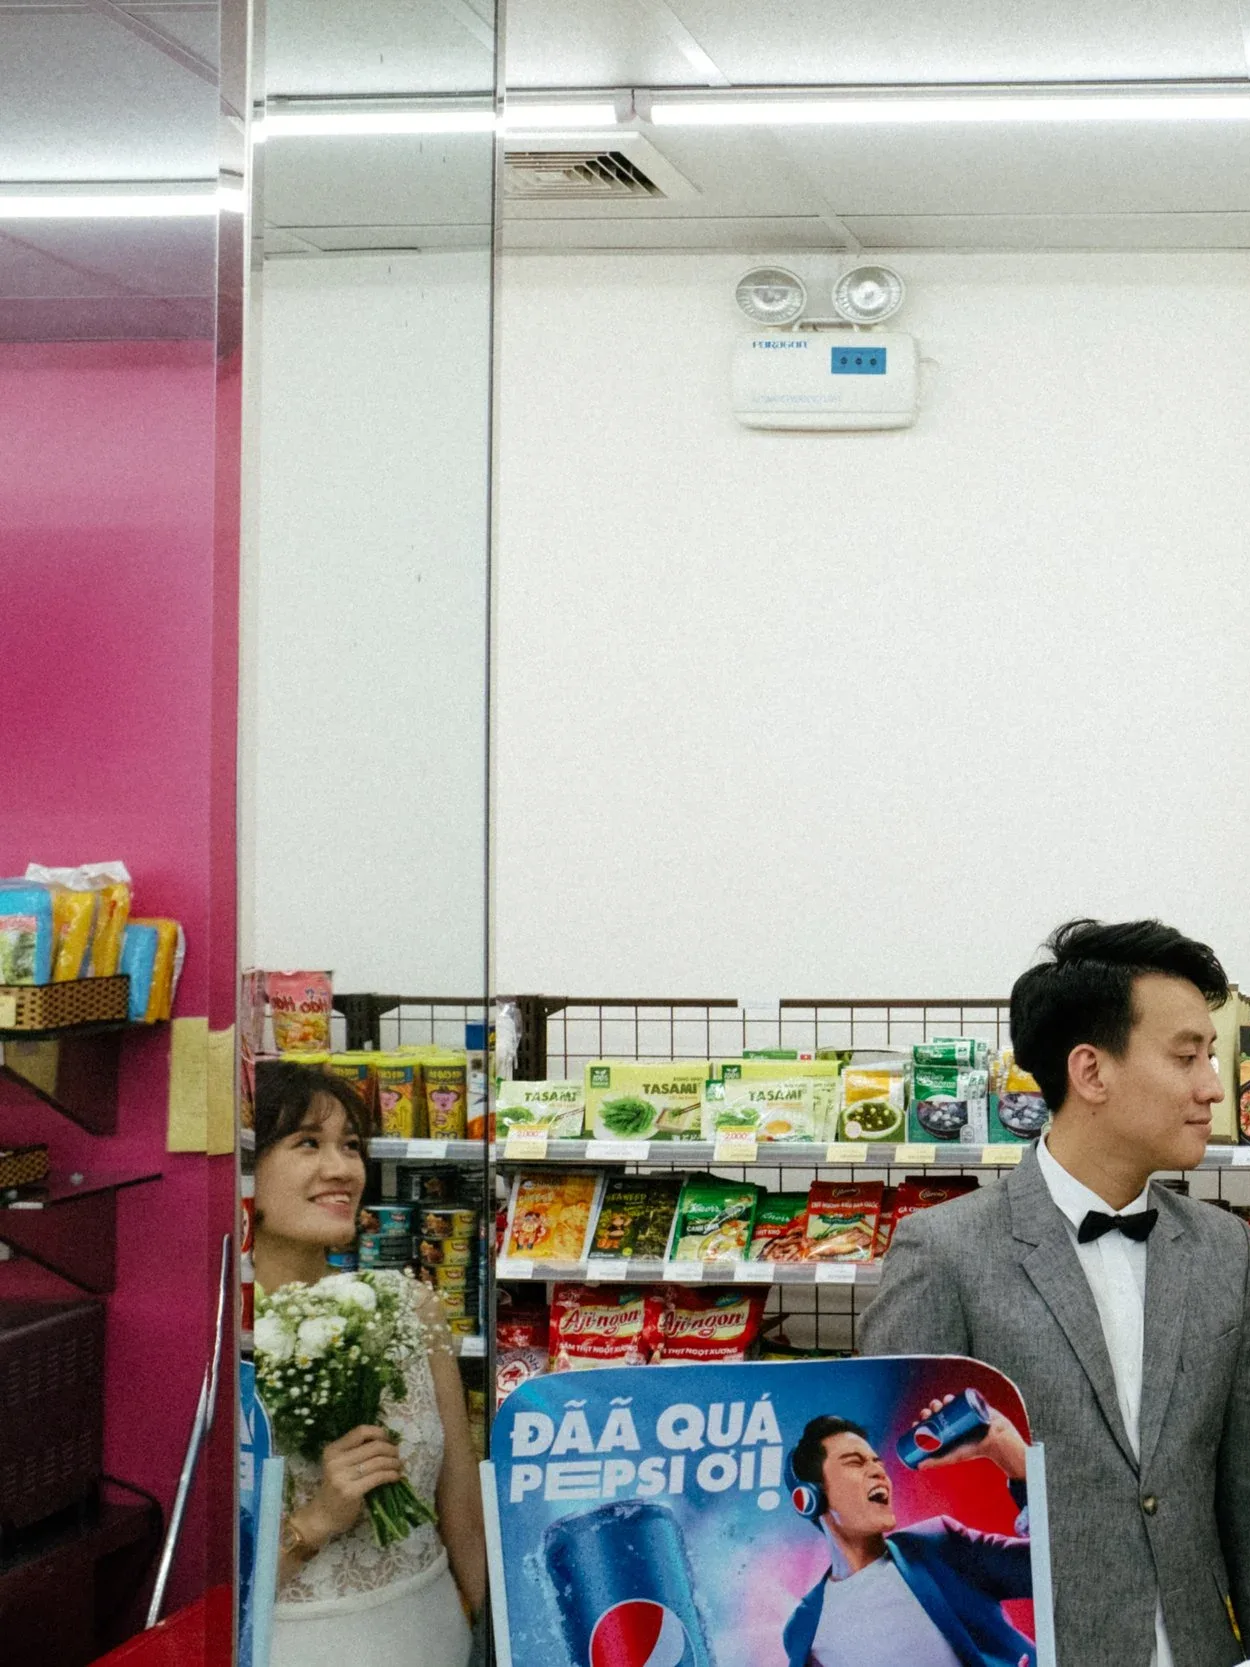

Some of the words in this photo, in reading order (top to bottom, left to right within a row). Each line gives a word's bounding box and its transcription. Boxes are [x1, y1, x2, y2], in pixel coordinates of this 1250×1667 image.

[524, 1091, 577, 1102] TASAMI
[642, 1083, 698, 1095] TASAMI
[748, 1090, 803, 1101] TASAMI
[562, 1308, 640, 1335] Aji-ngon
[661, 1310, 744, 1338] Aji-ngon
[510, 1397, 643, 1457] ĐÃÃ
[656, 1393, 783, 1450] QUÁ
[509, 1456, 684, 1503] PEPSI
